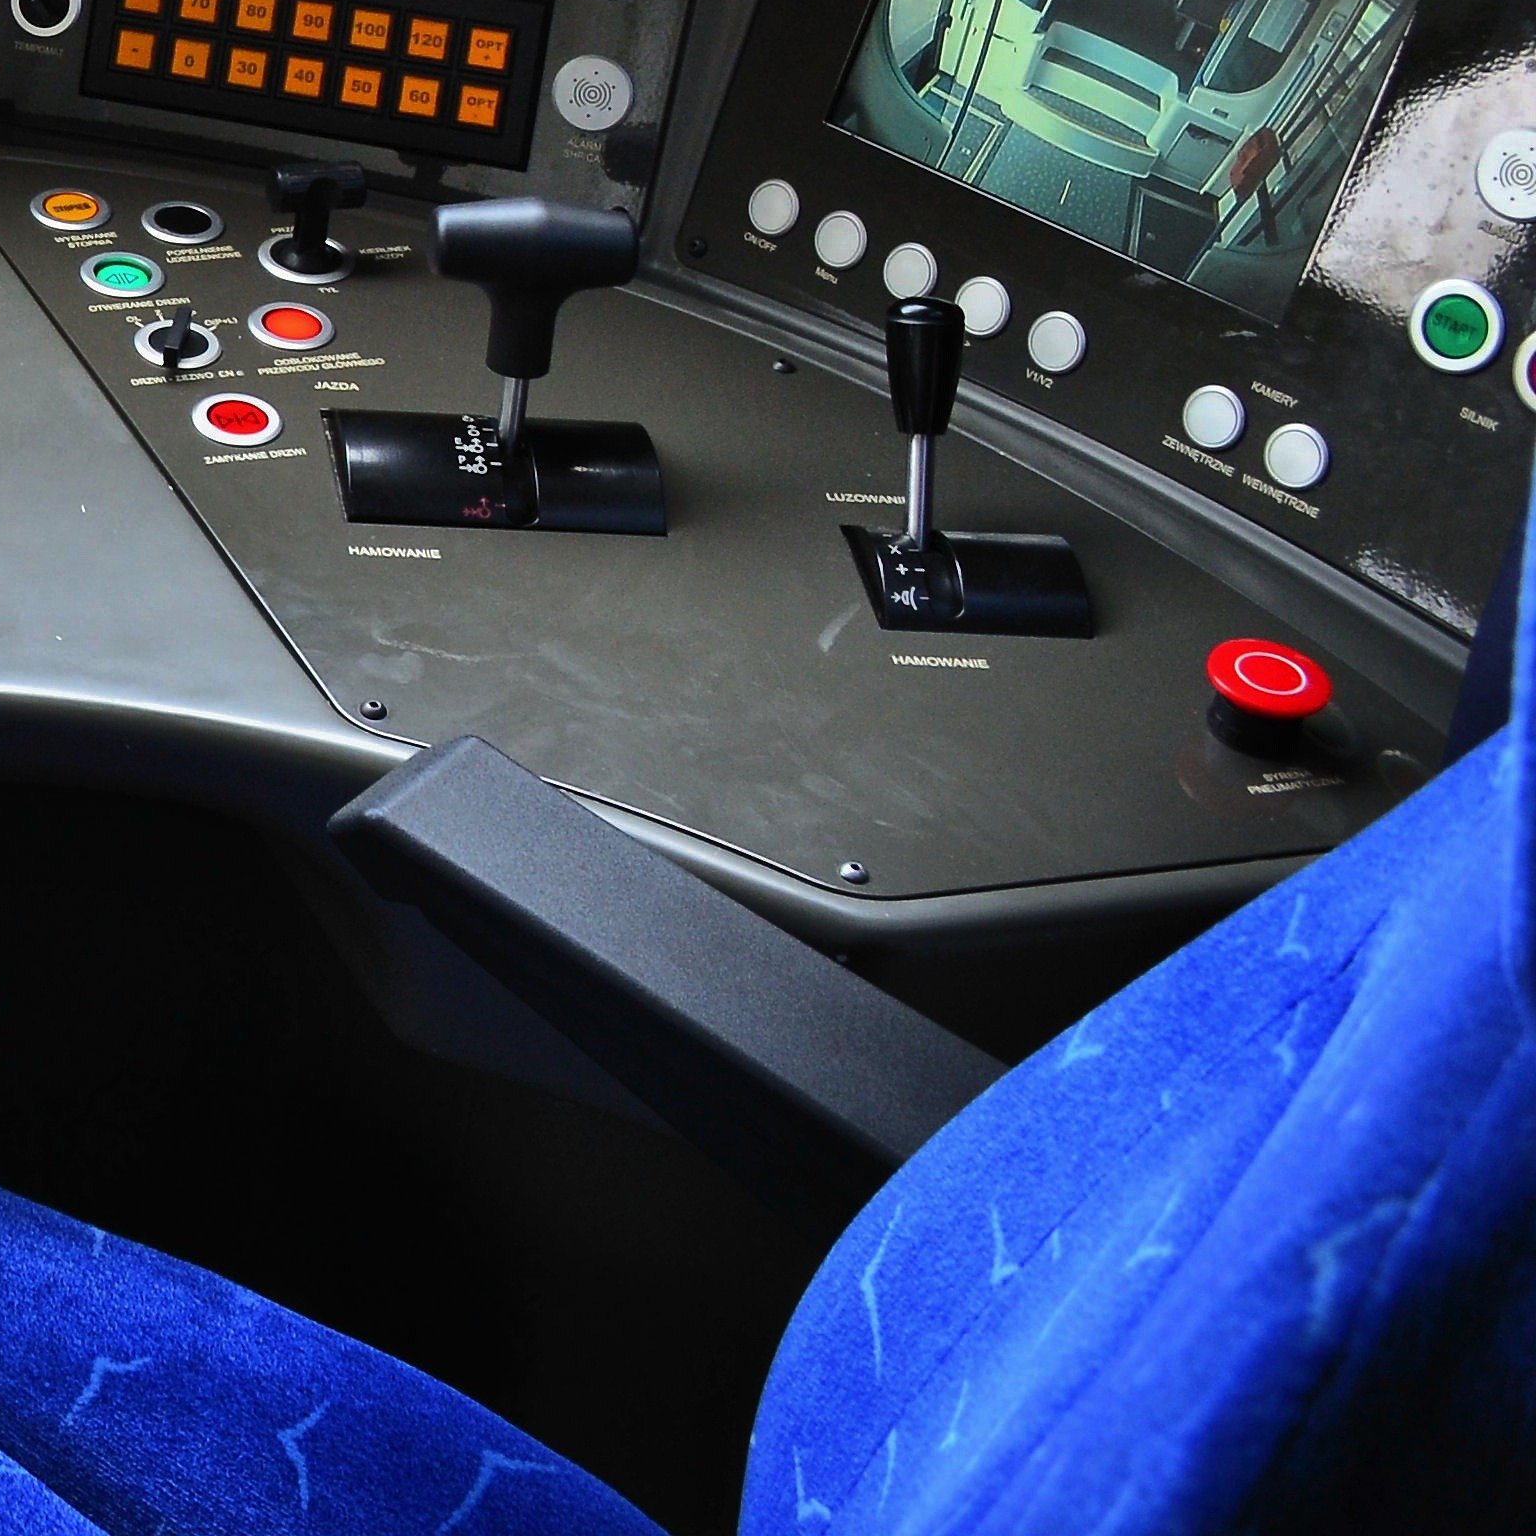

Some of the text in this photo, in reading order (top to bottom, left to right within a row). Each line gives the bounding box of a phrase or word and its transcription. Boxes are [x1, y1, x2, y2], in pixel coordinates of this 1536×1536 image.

[246, 5, 267, 19] 80
[303, 14, 324, 29] 90
[354, 22, 386, 38] 100
[412, 32, 443, 49] 120
[475, 38, 504, 53] OPT
[184, 54, 195, 68] 0
[237, 61, 258, 76] 30
[294, 70, 315, 84] 40
[351, 79, 372, 95] 50
[408, 89, 430, 105] 60
[466, 95, 496, 109] OPT
[567, 137, 602, 152] ALARM
[743, 231, 778, 252] ON/OFF
[815, 266, 839, 284] Menu
[88, 297, 191, 313] OTWIERANIE DRZWI
[1431, 313, 1478, 338] START
[257, 358, 386, 376] PRZEWODU GŁÓWNEGO
[1026, 367, 1055, 388] V1/V2
[314, 381, 360, 392] JAZDA
[1251, 381, 1298, 408] KAMERY
[1459, 406, 1499, 432] SILNIK
[203, 447, 307, 465] ZAMYKANIE DRZWI
[1162, 434, 1236, 477] ZEWNĘTRZNE
[1242, 473, 1320, 519] WEWNĘTRZNE
[348, 544, 442, 560] HAMOWANIE
[891, 654, 990, 670] HAMOWANIE
